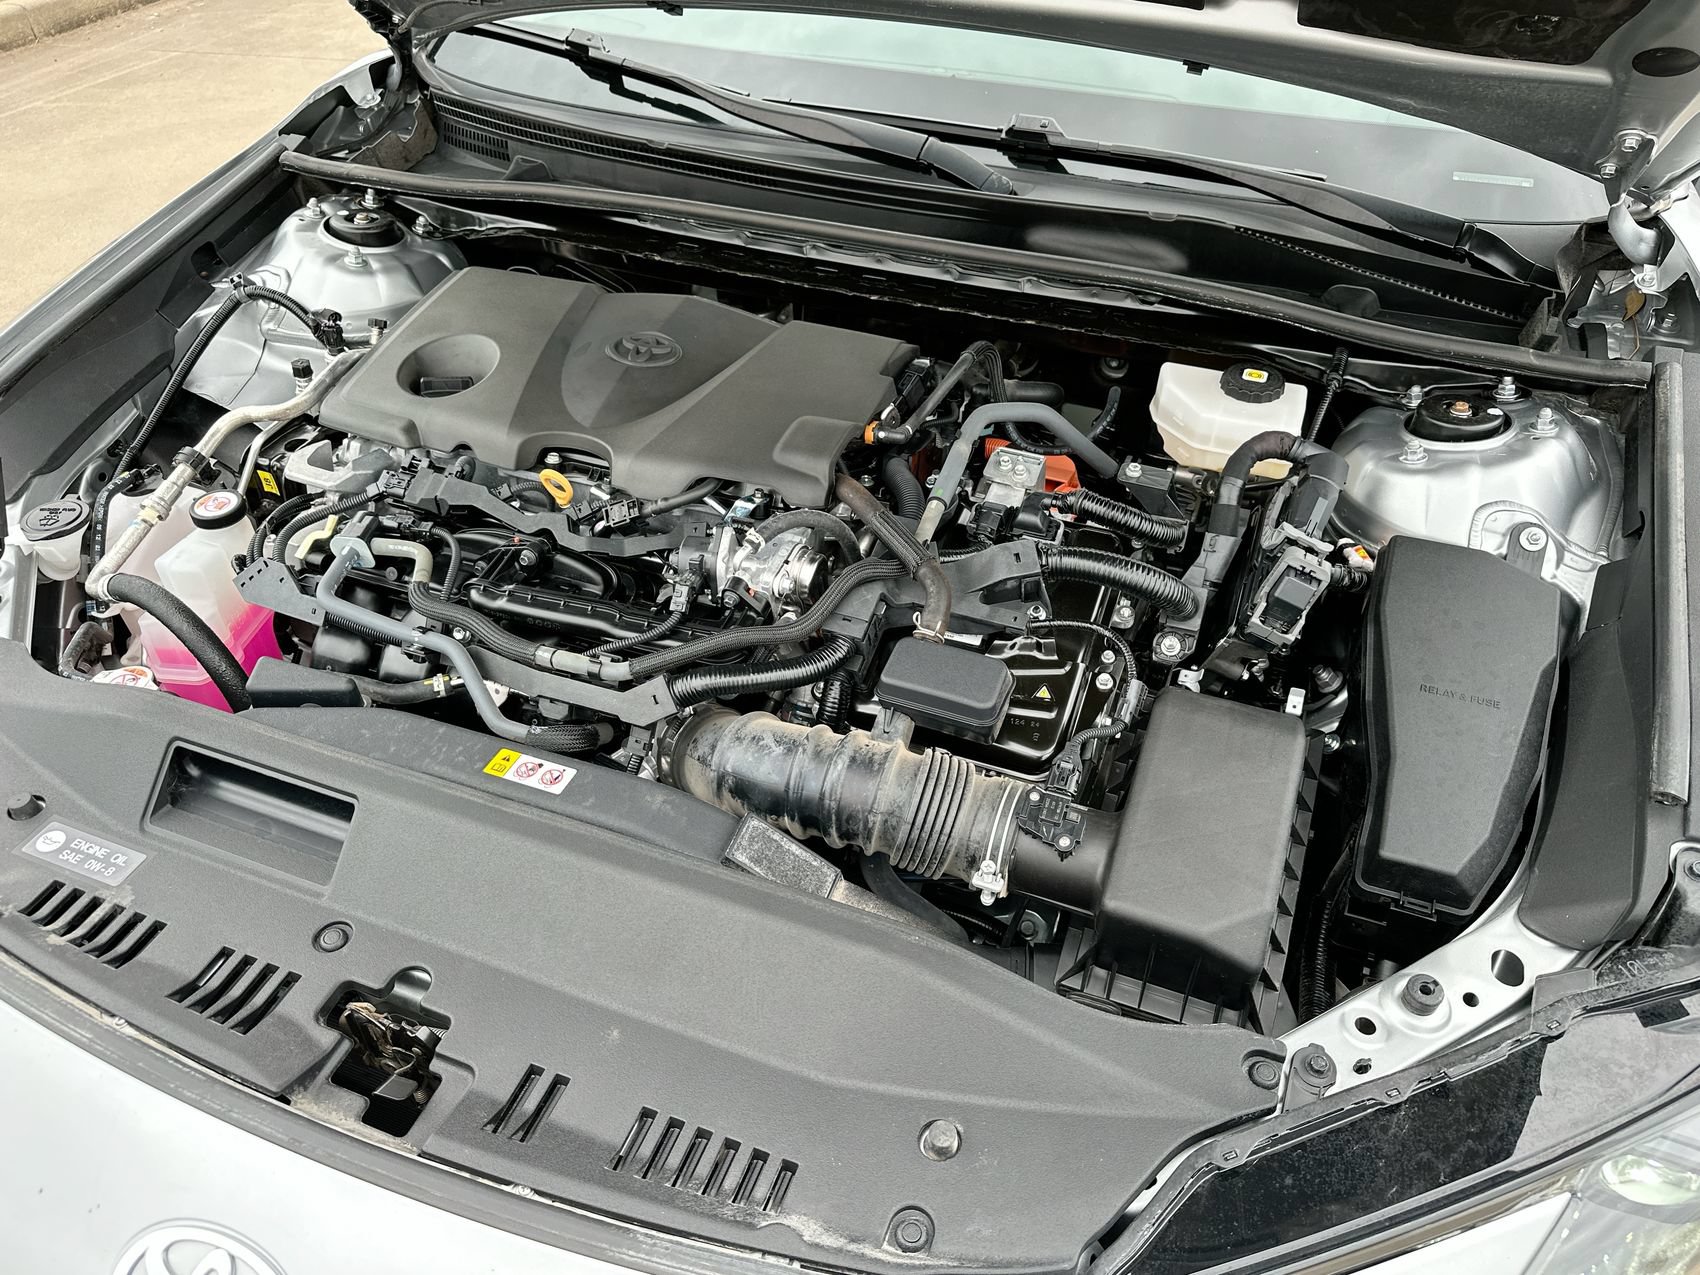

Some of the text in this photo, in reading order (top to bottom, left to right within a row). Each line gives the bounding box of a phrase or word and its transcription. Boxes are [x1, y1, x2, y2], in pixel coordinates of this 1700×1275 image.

[1419, 683, 1501, 709] RELAY & FUSE
[59, 849, 116, 877] SAE 0W-8
[70, 838, 129, 866] ENGINE OIL
